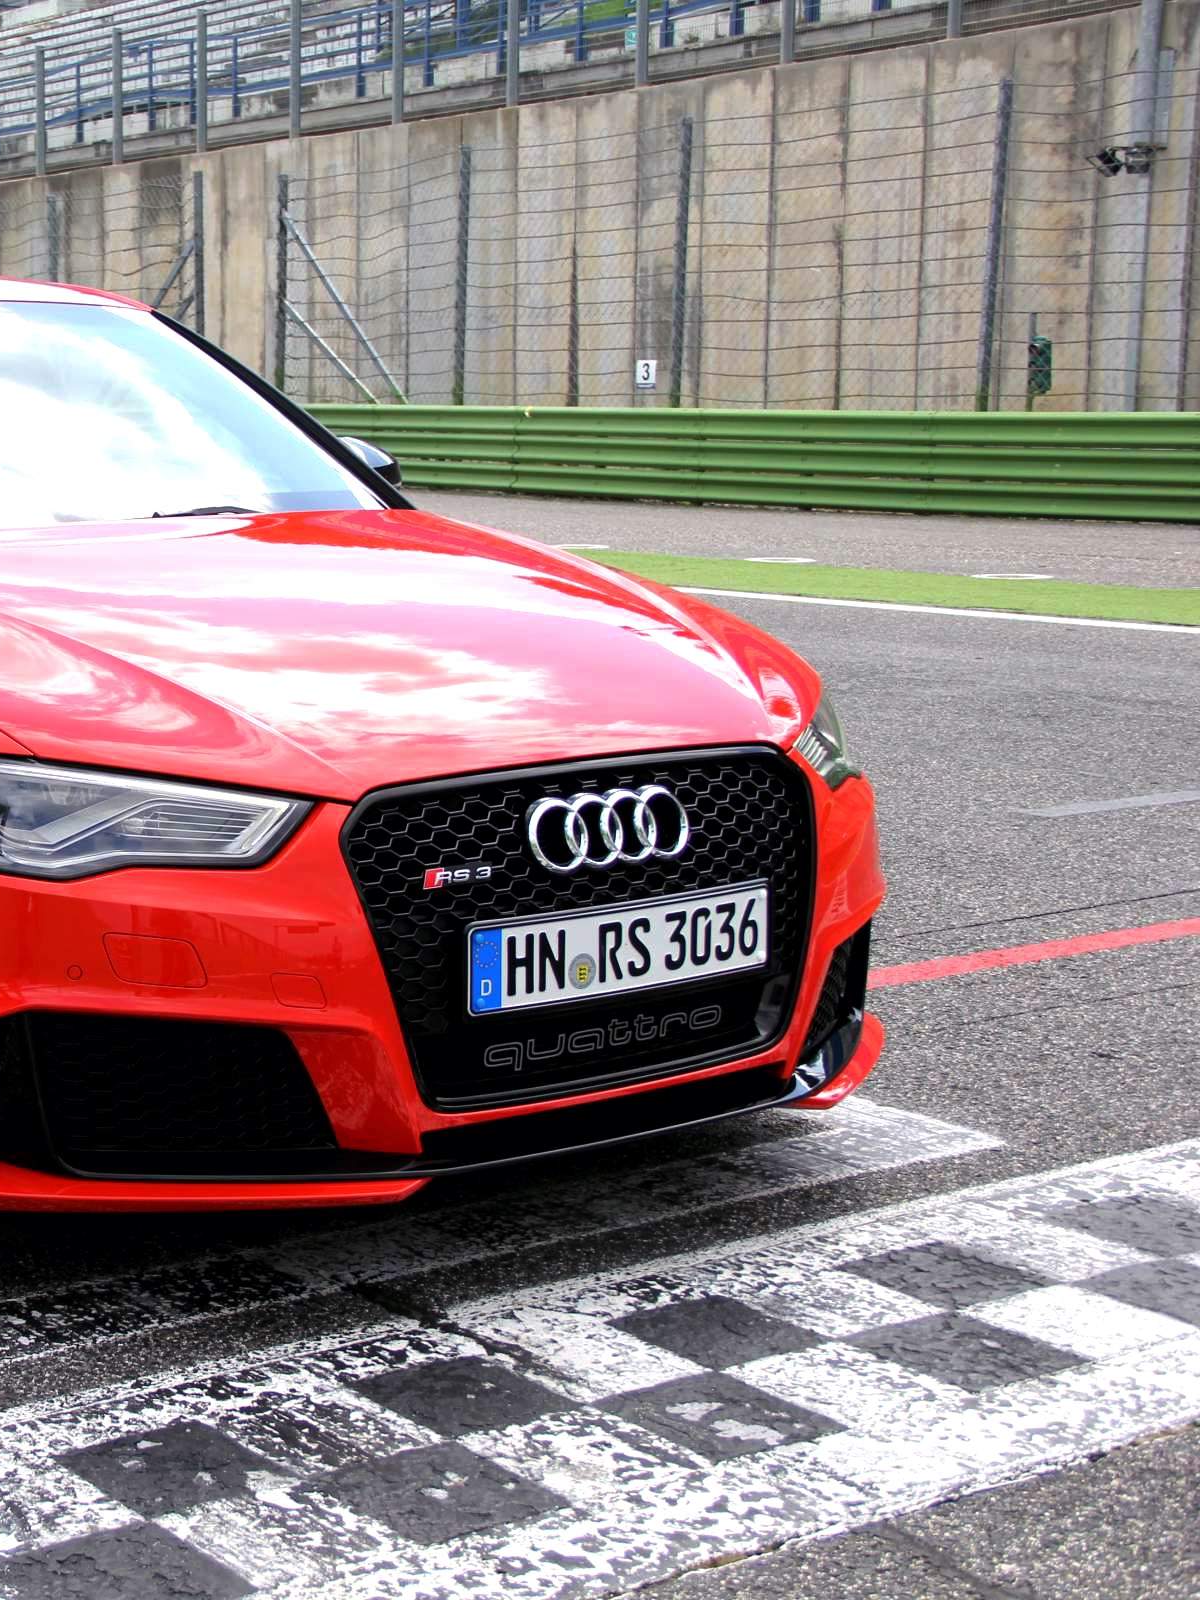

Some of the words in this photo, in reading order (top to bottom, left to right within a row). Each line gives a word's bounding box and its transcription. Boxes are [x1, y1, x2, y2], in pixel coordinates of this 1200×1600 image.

[642, 363, 650, 380] 3
[434, 869, 471, 884] RS
[475, 866, 492, 879] 3
[506, 929, 566, 997] HN
[598, 917, 651, 983] RS
[664, 898, 758, 970] 3036
[480, 978, 493, 997] D
[484, 1005, 721, 1071] quattro
